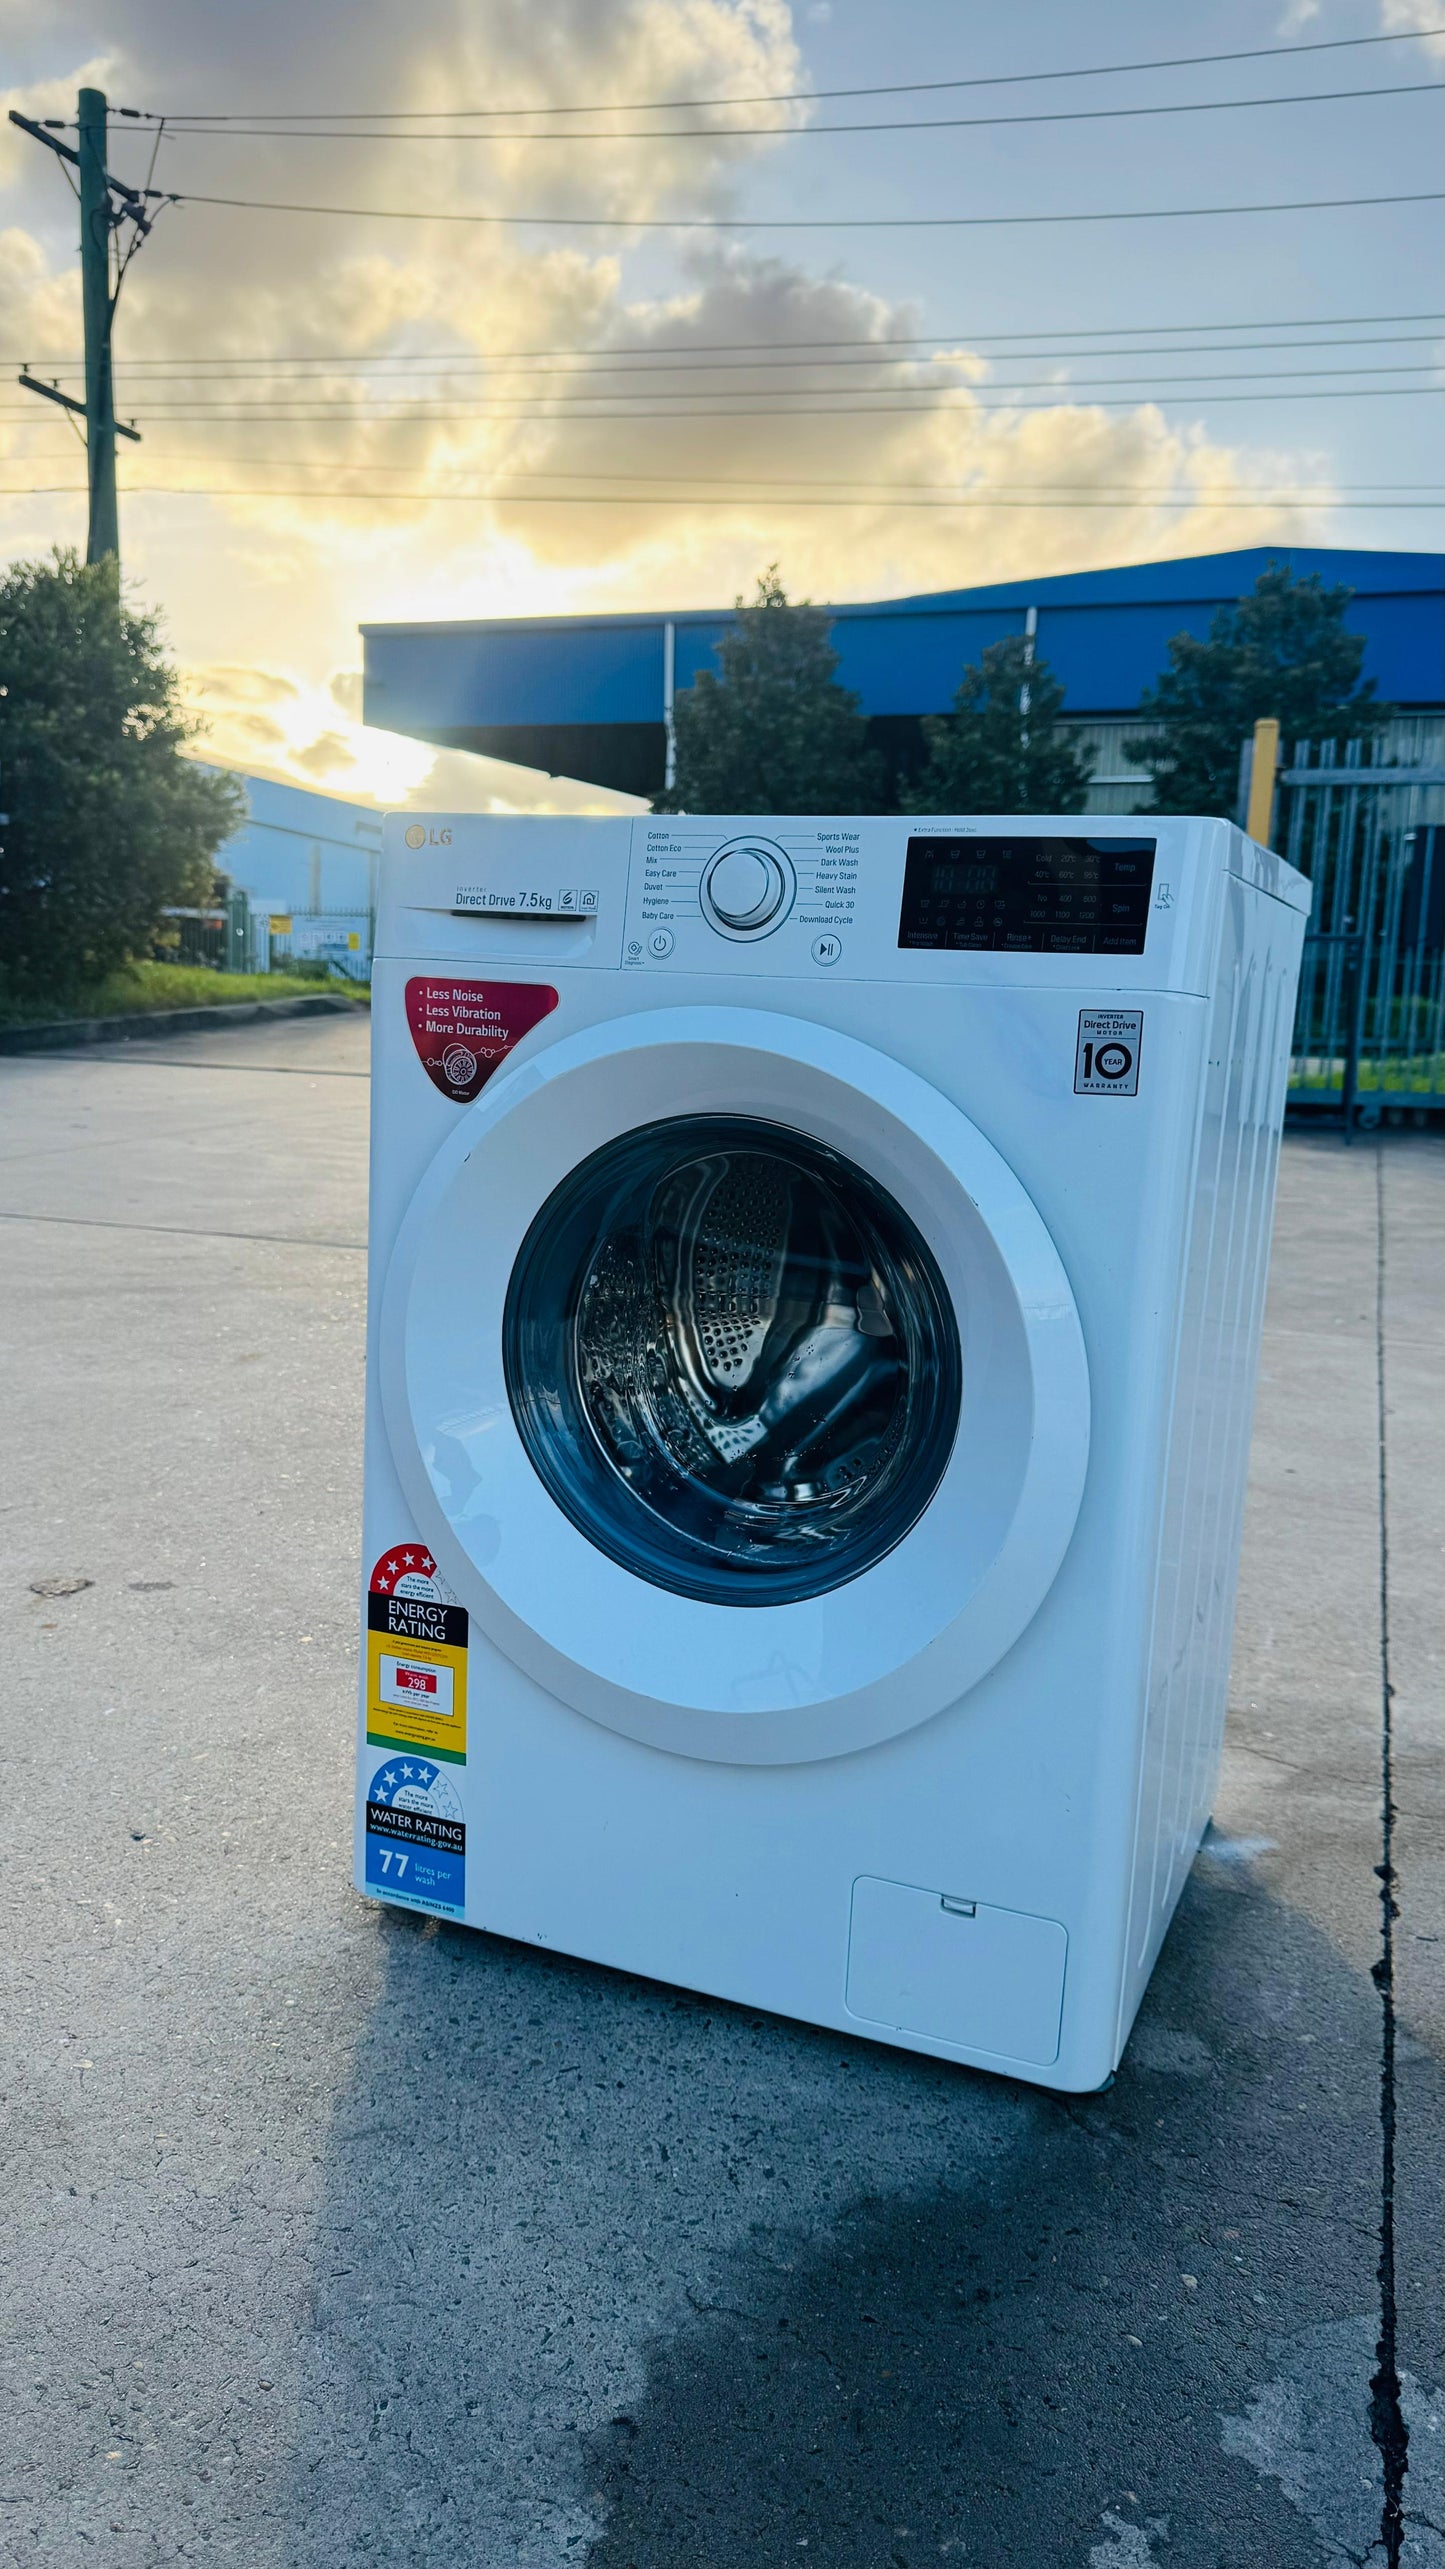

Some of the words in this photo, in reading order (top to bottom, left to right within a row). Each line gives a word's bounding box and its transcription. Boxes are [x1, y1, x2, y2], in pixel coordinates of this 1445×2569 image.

[429, 828, 452, 846] LG
[648, 832, 669, 840] Cotton
[816, 832, 840, 842] Sports
[840, 833, 861, 841] Wear
[647, 844, 669, 852] Cotton
[669, 844, 682, 852] Eco
[825, 845, 843, 854] Wool
[844, 846, 859, 854] Plus
[646, 856, 658, 864] Mix
[820, 858, 837, 866] Dark
[838, 858, 859, 867] Wash
[1036, 854, 1052, 863] Cold
[1115, 863, 1136, 873] Temp
[645, 869, 661, 879] Easy
[662, 870, 677, 878] Care
[816, 872, 838, 881] Heavy
[839, 872, 858, 880] Stain
[644, 883, 663, 891] Duvet
[814, 885, 834, 894] Silent
[835, 886, 856, 895] Wash
[456, 894, 486, 906] Direct
[489, 894, 516, 906] Drive
[518, 892, 552, 909] 7.5kg
[642, 897, 669, 906] Hygiene
[825, 900, 845, 910] Quick
[846, 900, 855, 909] 30
[1112, 904, 1130, 913] Spin
[642, 912, 659, 921] Baby
[660, 912, 674, 920] Care
[799, 915, 833, 925] Download
[834, 916, 853, 925] Cycle
[952, 932, 969, 940] Time
[970, 932, 989, 941] Save
[1051, 934, 1071, 944] Delay
[1072, 935, 1087, 943] End
[1103, 937, 1118, 945] Add
[426, 987, 450, 999] Less
[452, 989, 483, 1002] Noise
[426, 1004, 449, 1016] Less
[452, 1006, 501, 1020] Vibration
[1084, 1020, 1111, 1029] Direct
[1112, 1021, 1136, 1029] Drive
[426, 1021, 454, 1033] More
[456, 1023, 509, 1041] Durability
[1083, 1042, 1132, 1080] 10
[388, 1600, 448, 1623] ENERGY
[388, 1616, 446, 1640] RATING
[408, 1677, 426, 1690] 298
[371, 1808, 412, 1829] WATER
[416, 1820, 462, 1841] RATING
[370, 1823, 462, 1851] www.waterrating.gov.au
[379, 1849, 409, 1878] 77
[415, 1863, 435, 1876] litres
[437, 1869, 452, 1881] per
[415, 1876, 435, 1886] wash
